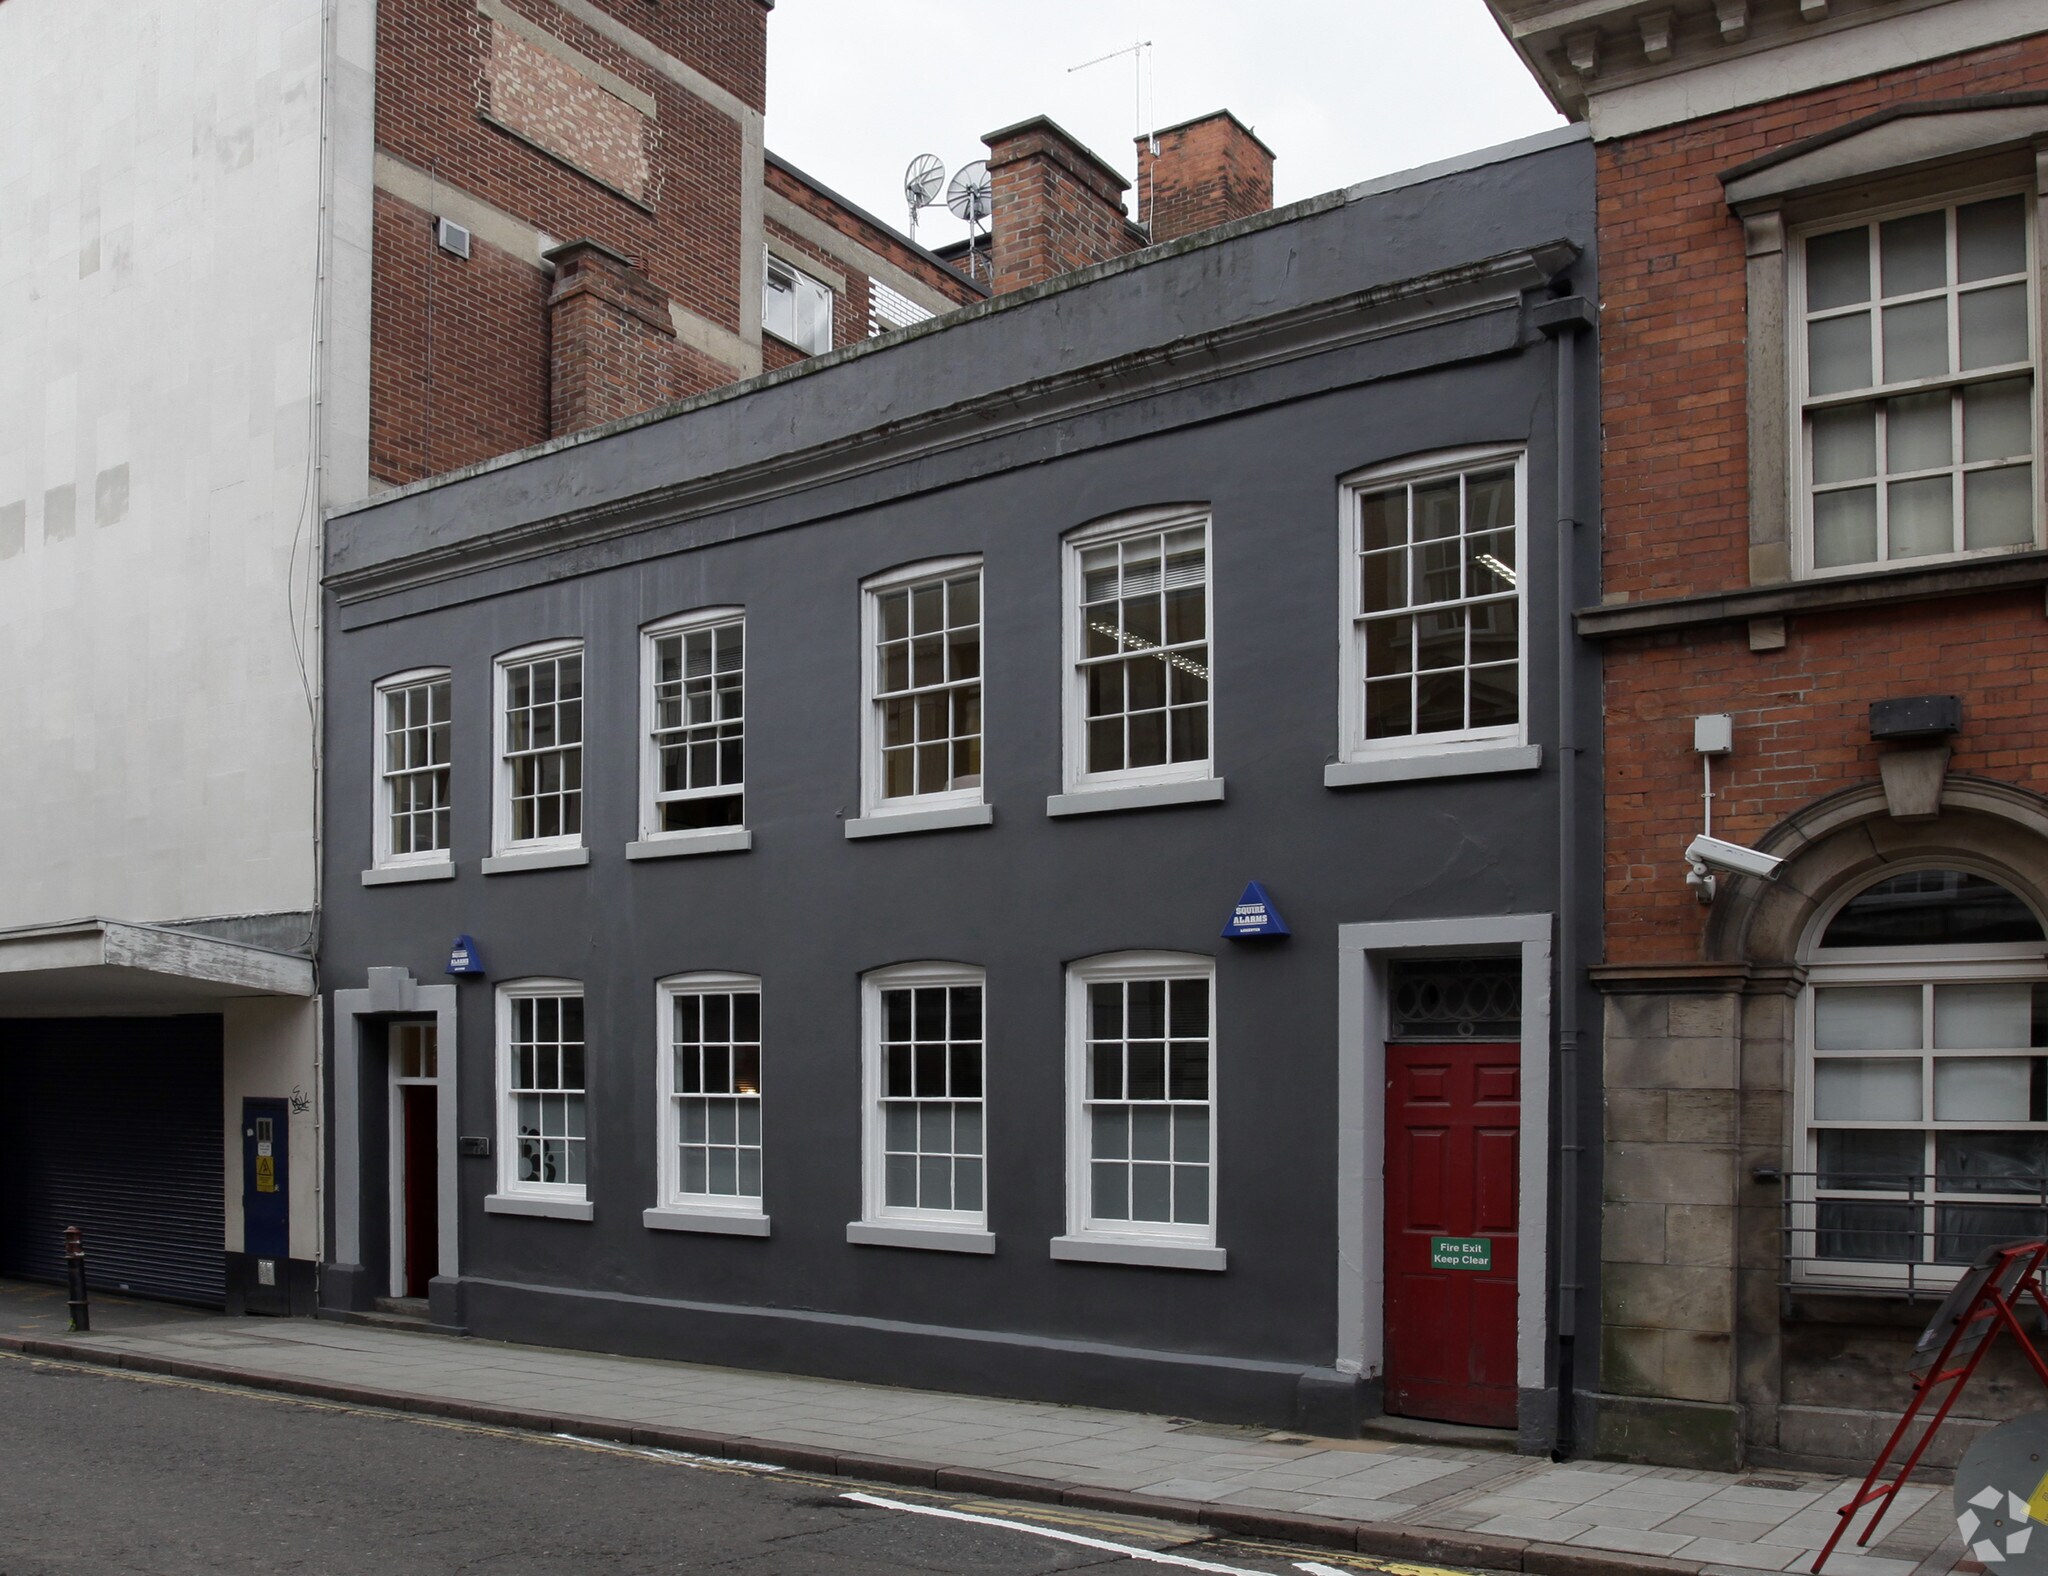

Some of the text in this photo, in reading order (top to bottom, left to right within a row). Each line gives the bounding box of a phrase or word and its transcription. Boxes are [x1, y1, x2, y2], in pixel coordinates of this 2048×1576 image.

[1235, 905, 1265, 915] SQUIRE
[1233, 914, 1267, 924] ALARMS
[1440, 1243, 1482, 1253] Fire Exit
[1434, 1254, 1489, 1265] Keep Clear
